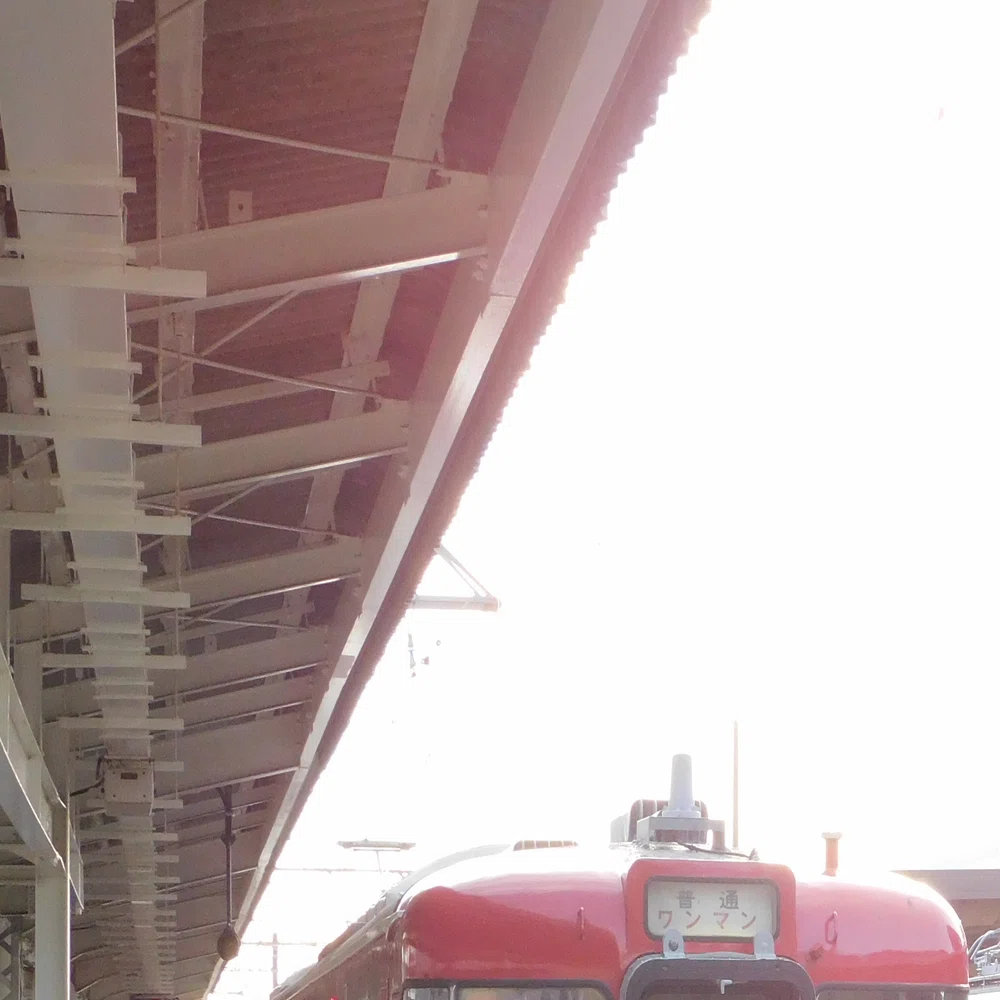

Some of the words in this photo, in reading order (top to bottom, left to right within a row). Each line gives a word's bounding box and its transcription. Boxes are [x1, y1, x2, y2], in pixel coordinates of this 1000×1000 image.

[676, 890, 739, 909] 普通
[659, 911, 756, 929] ワンマン
